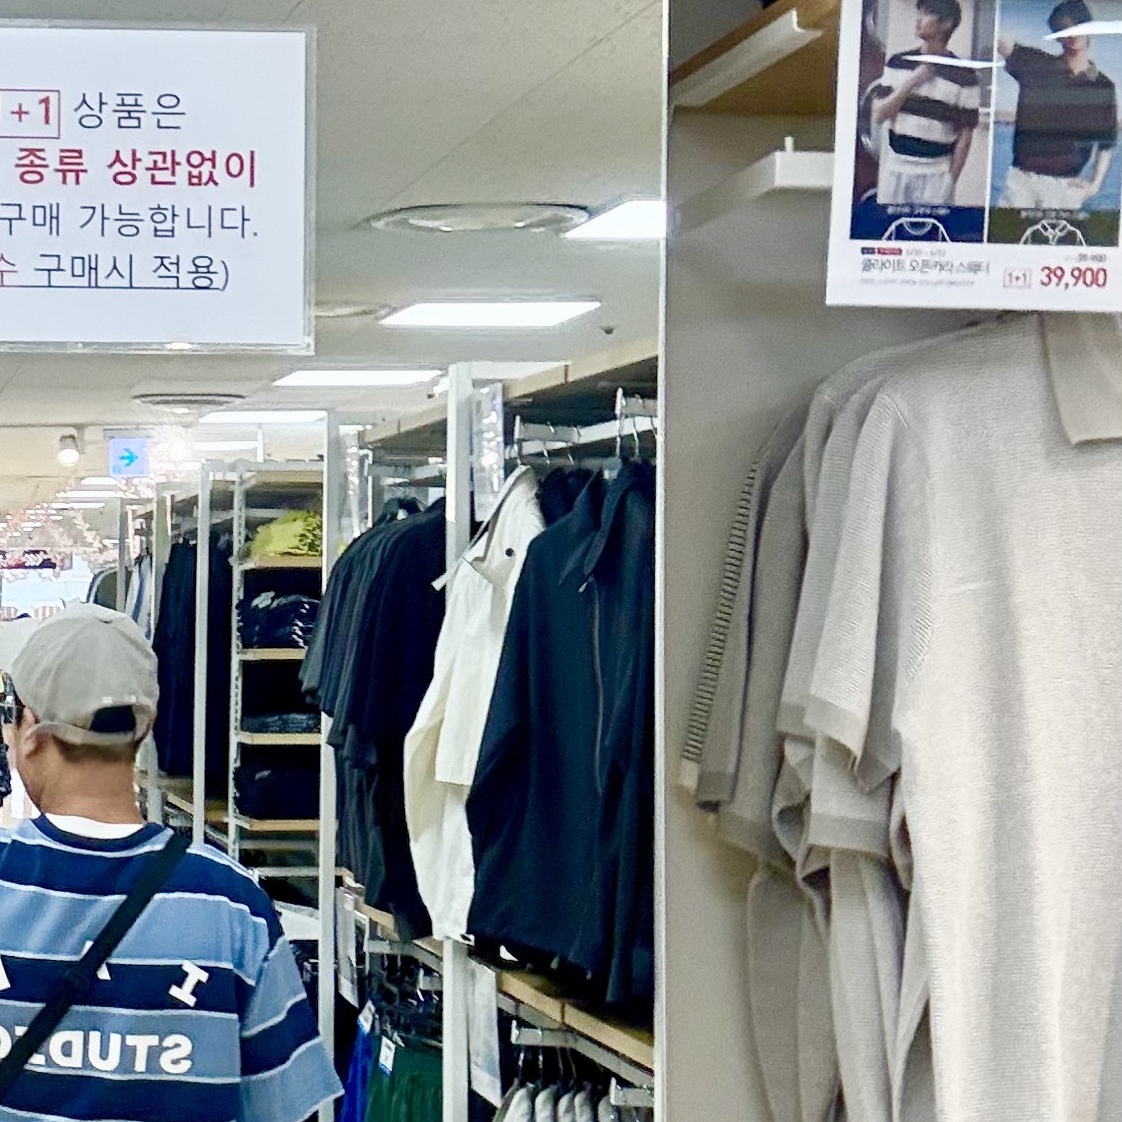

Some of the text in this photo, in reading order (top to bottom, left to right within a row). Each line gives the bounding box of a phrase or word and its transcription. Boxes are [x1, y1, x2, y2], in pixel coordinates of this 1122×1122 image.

[74, 92, 186, 129] 상품은
[14, 147, 88, 186] 종류
[107, 149, 256, 187] 상관없이
[79, 204, 258, 238] 가능합니다.
[34, 253, 134, 288] 구매시
[152, 255, 229, 291] 적용)
[1008, 266, 1107, 291] 1+1 39,900
